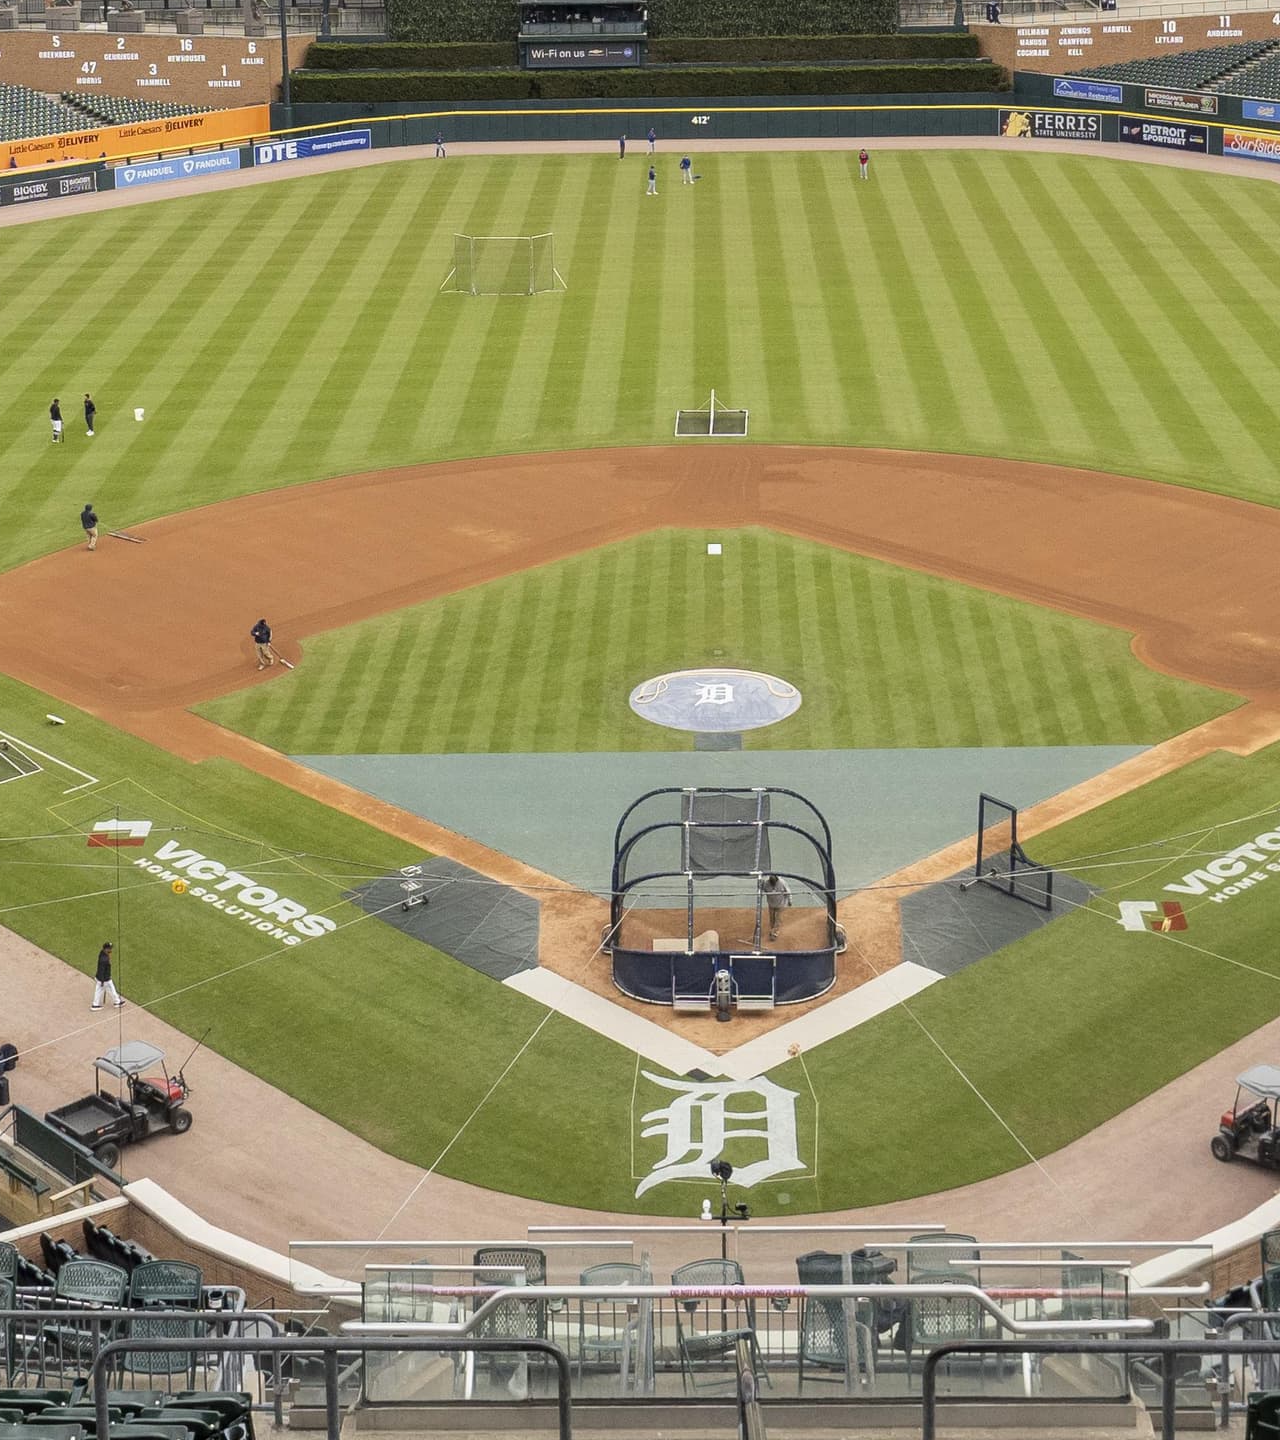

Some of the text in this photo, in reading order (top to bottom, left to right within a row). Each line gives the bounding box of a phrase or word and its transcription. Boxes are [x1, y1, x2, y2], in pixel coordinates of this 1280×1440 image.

[1162, 20, 1176, 33] 10
[1220, 15, 1230, 27] 11
[180, 39, 192, 51] 16
[531, 50, 557, 58] Wi-Fi
[81, 62, 96, 73] 47
[1035, 114, 1097, 131] FERRIS
[120, 125, 162, 138] Little Caesars
[1035, 129, 1096, 140] STATE UNIVERSITY
[1143, 124, 1186, 138] DETROIT
[9, 140, 54, 154] Little Caesars
[1143, 135, 1186, 145] SPORTSNET
[1231, 133, 1280, 155] Surfside
[260, 142, 297, 163] DTE
[195, 157, 232, 170] FANDUEL
[137, 165, 174, 179] FANDUEL
[153, 840, 337, 937] VICTORS
[1208, 871, 1269, 903] HOME
[133, 857, 302, 946] HOME SOLUTIONS
[633, 1069, 809, 1200] D
